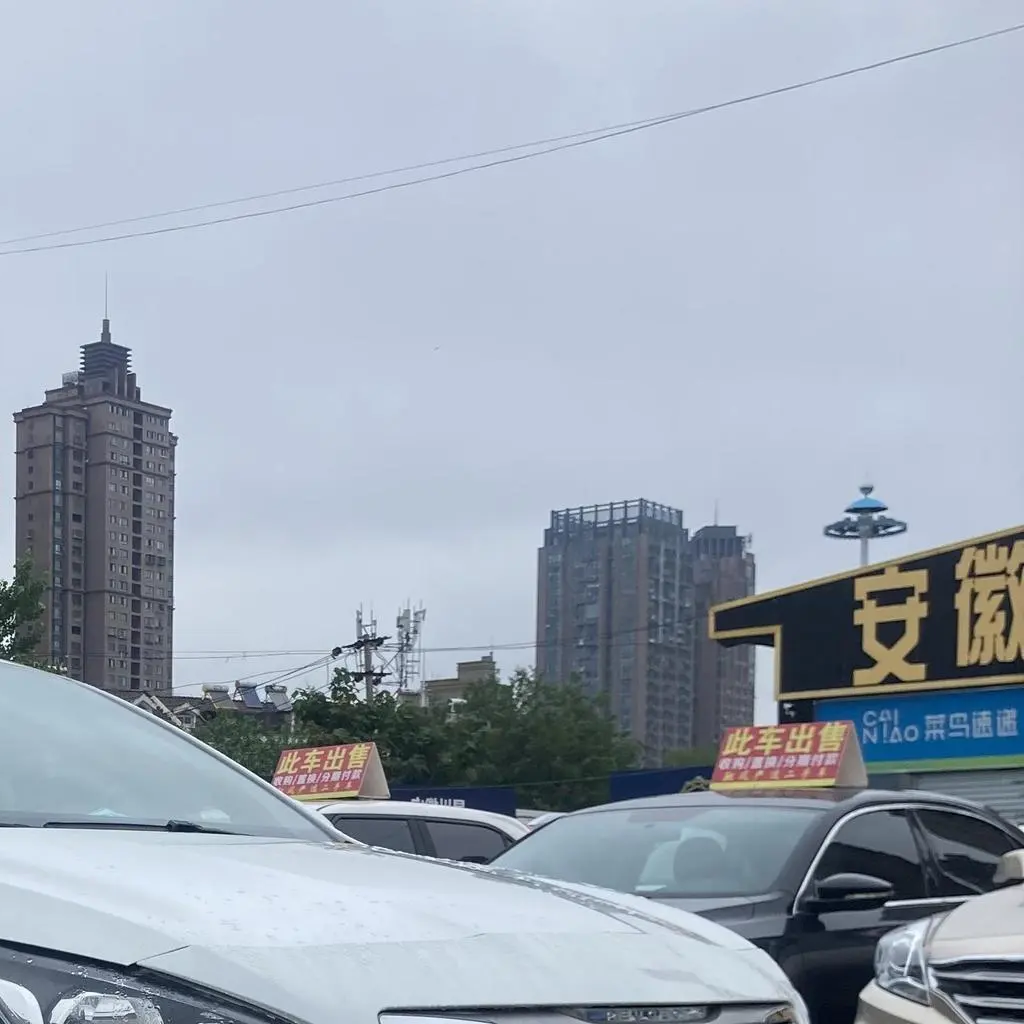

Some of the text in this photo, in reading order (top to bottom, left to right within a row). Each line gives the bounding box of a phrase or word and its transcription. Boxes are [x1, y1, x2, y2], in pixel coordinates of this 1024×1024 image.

[722, 722, 847, 756] 此车出售
[277, 743, 371, 775] 此车出售
